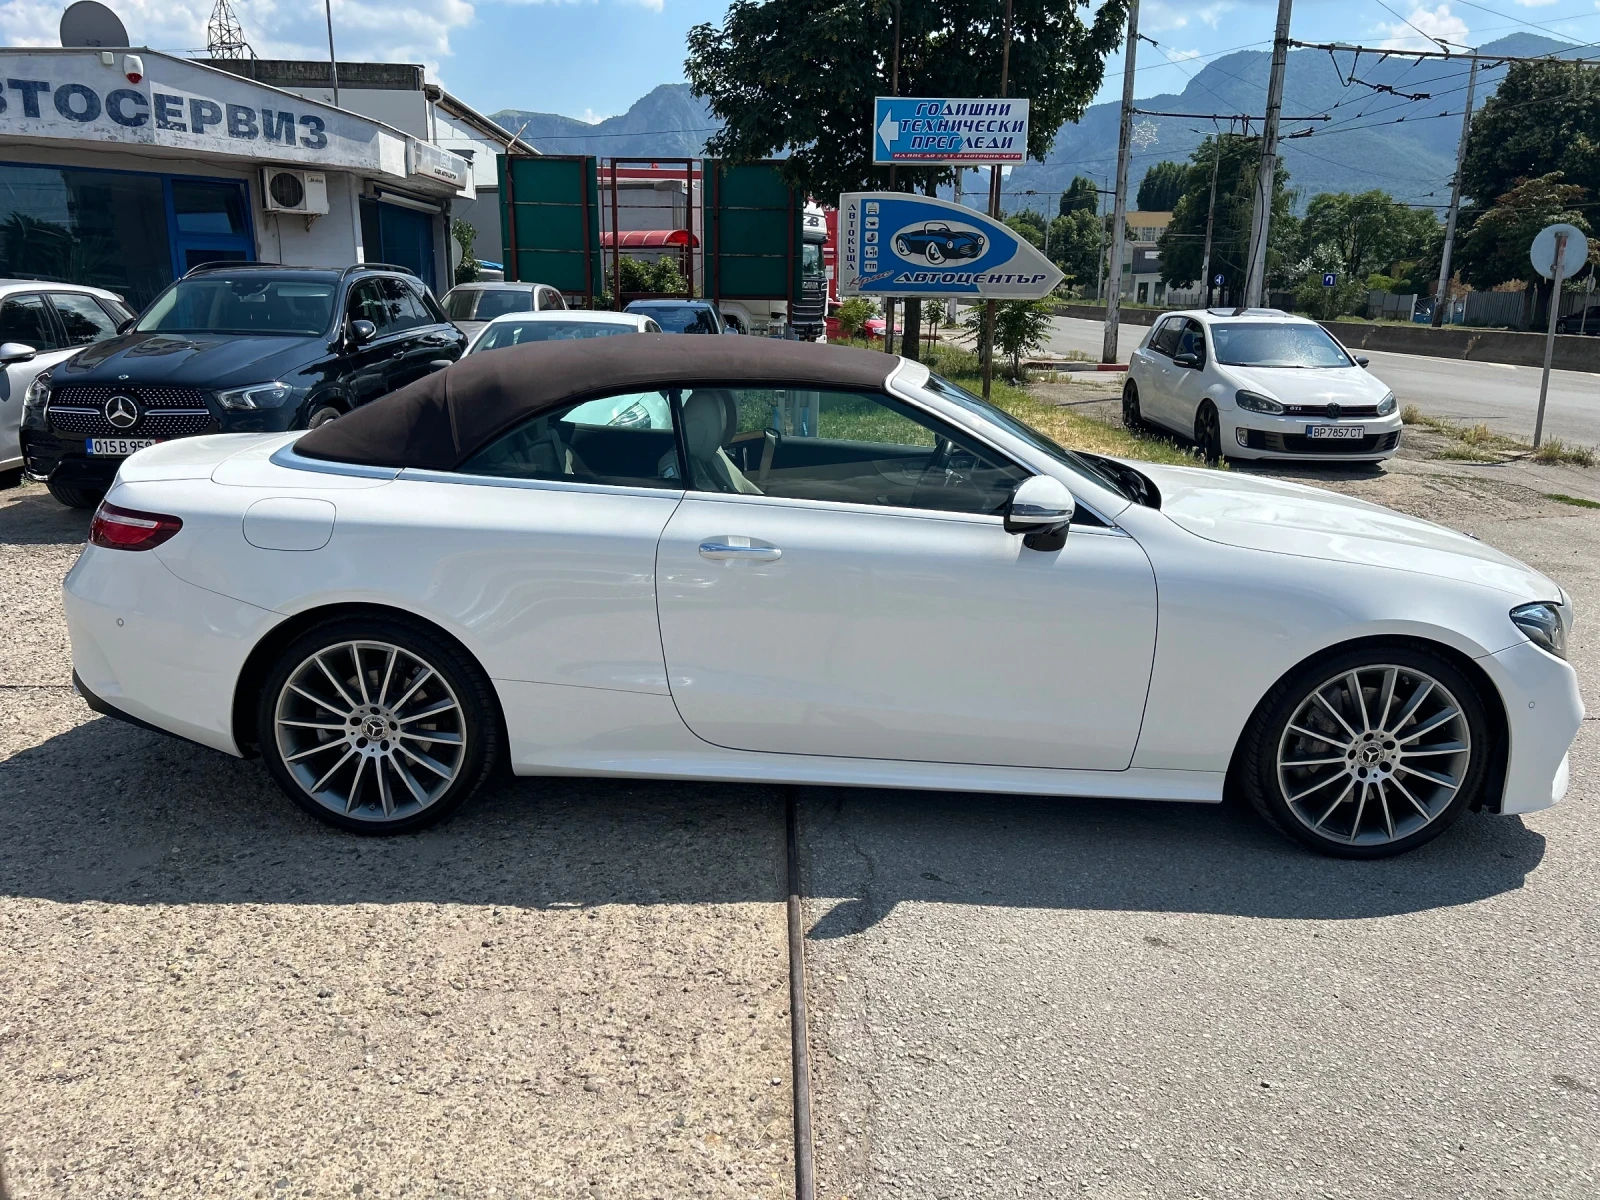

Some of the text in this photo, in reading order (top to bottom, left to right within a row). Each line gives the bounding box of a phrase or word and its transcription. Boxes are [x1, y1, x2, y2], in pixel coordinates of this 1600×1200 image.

[0, 78, 329, 149] ТОСЕРВИЗ
[915, 102, 1012, 116] ГОДИШНИ
[901, 119, 1025, 133] ТЕХНИЧЕСКИ
[910, 136, 1014, 149] ПРЕГЛЕДИ
[846, 203, 857, 270] АВТОКЪЩА
[894, 272, 1047, 285] АВТОЦЕНТЪР
[1327, 428, 1350, 437] 7857
